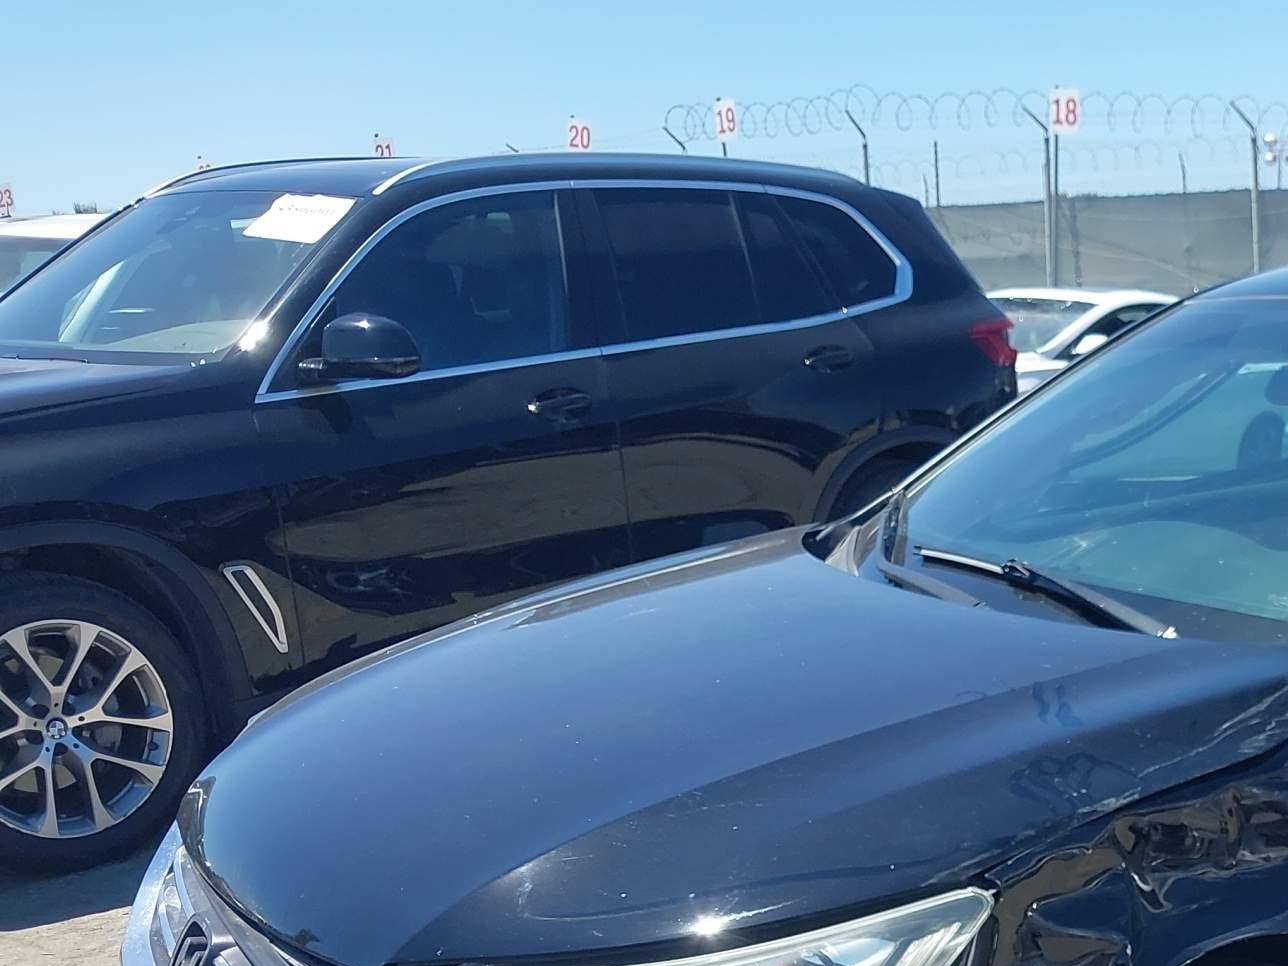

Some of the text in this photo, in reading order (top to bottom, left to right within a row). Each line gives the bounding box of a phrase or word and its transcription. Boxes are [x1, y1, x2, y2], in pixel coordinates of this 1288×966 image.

[717, 107, 736, 134] 19
[1052, 97, 1077, 126] 18
[569, 125, 591, 150] 20
